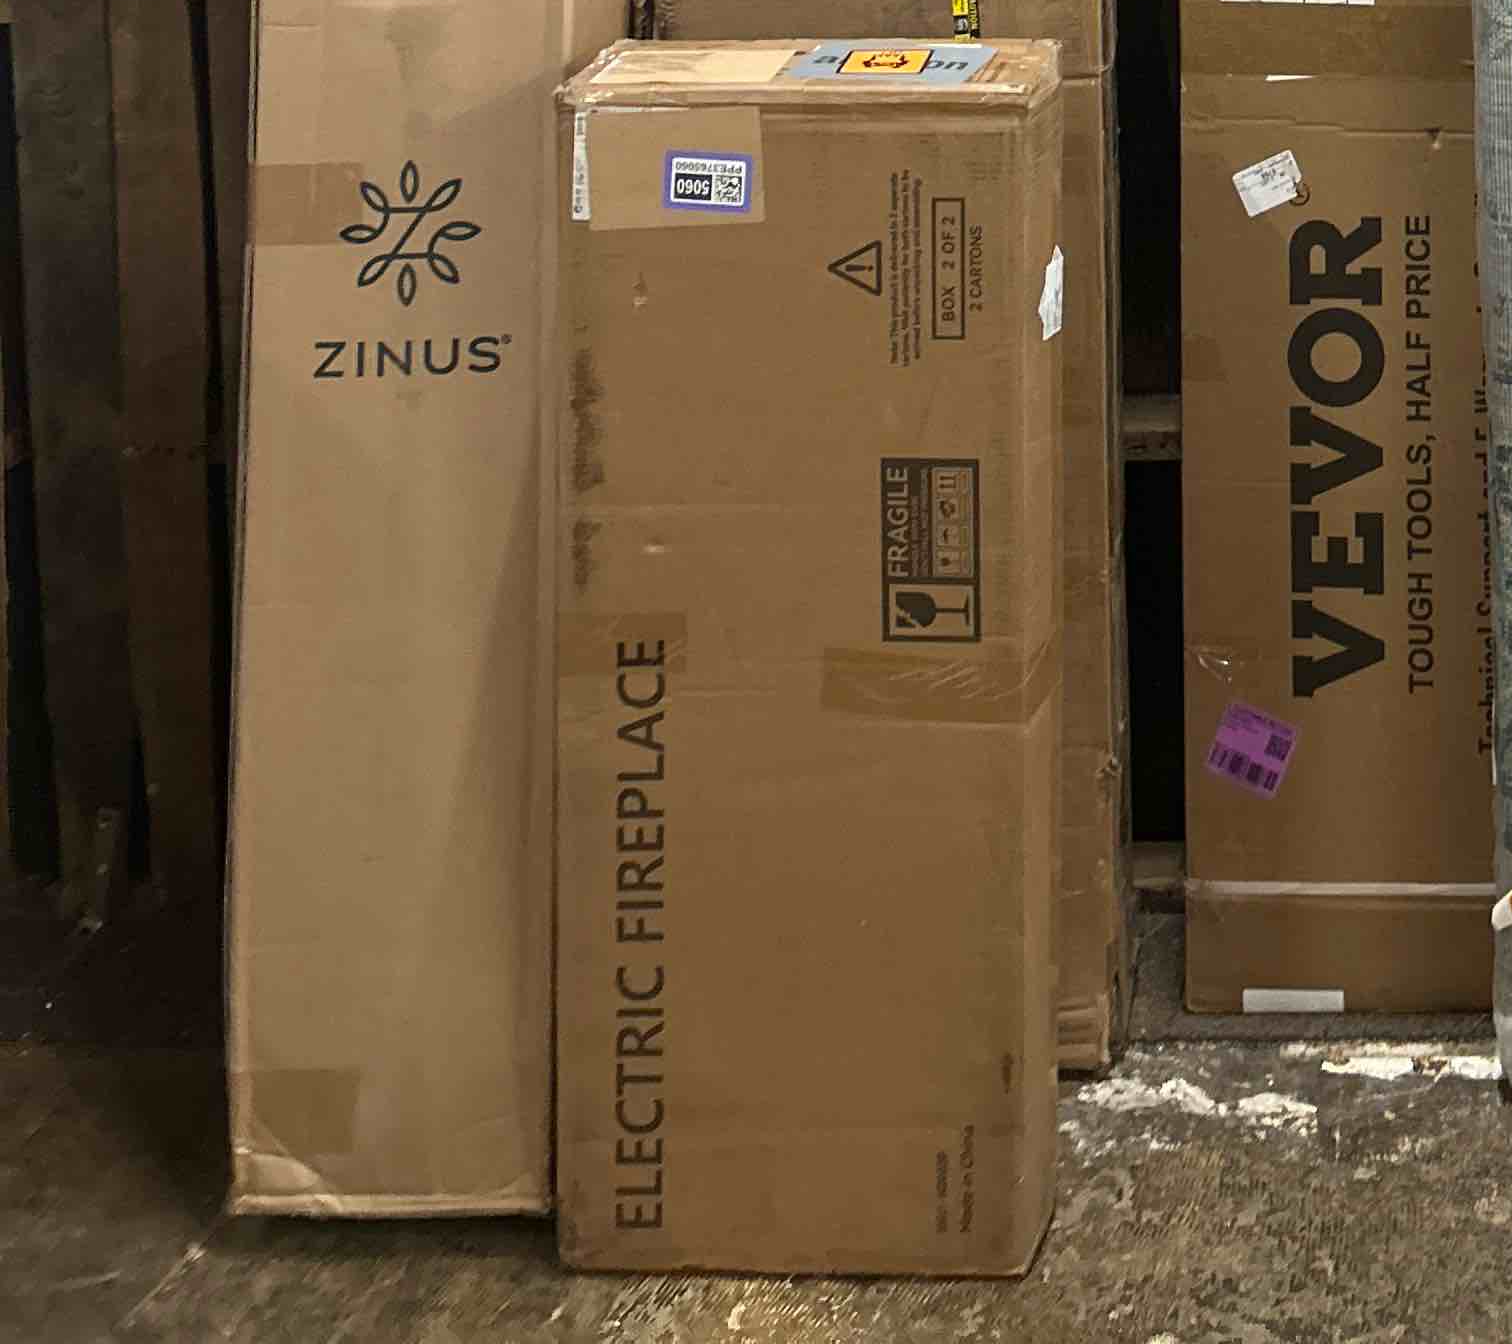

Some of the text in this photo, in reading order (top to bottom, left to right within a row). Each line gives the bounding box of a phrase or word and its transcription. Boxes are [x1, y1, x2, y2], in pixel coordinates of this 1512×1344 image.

[676, 178, 711, 195] 5060
[941, 216, 955, 321] BOX 2 OF 2
[969, 224, 983, 312] 2 CARTONS
[313, 335, 503, 378] ZINUS
[1288, 216, 1385, 698] VEVOR
[1405, 215, 1437, 694] TOUGH TOOLS, HALF PRICE
[887, 467, 909, 577] FRAGILE
[615, 639, 666, 1230] ELECTRIC FIREPLACE
